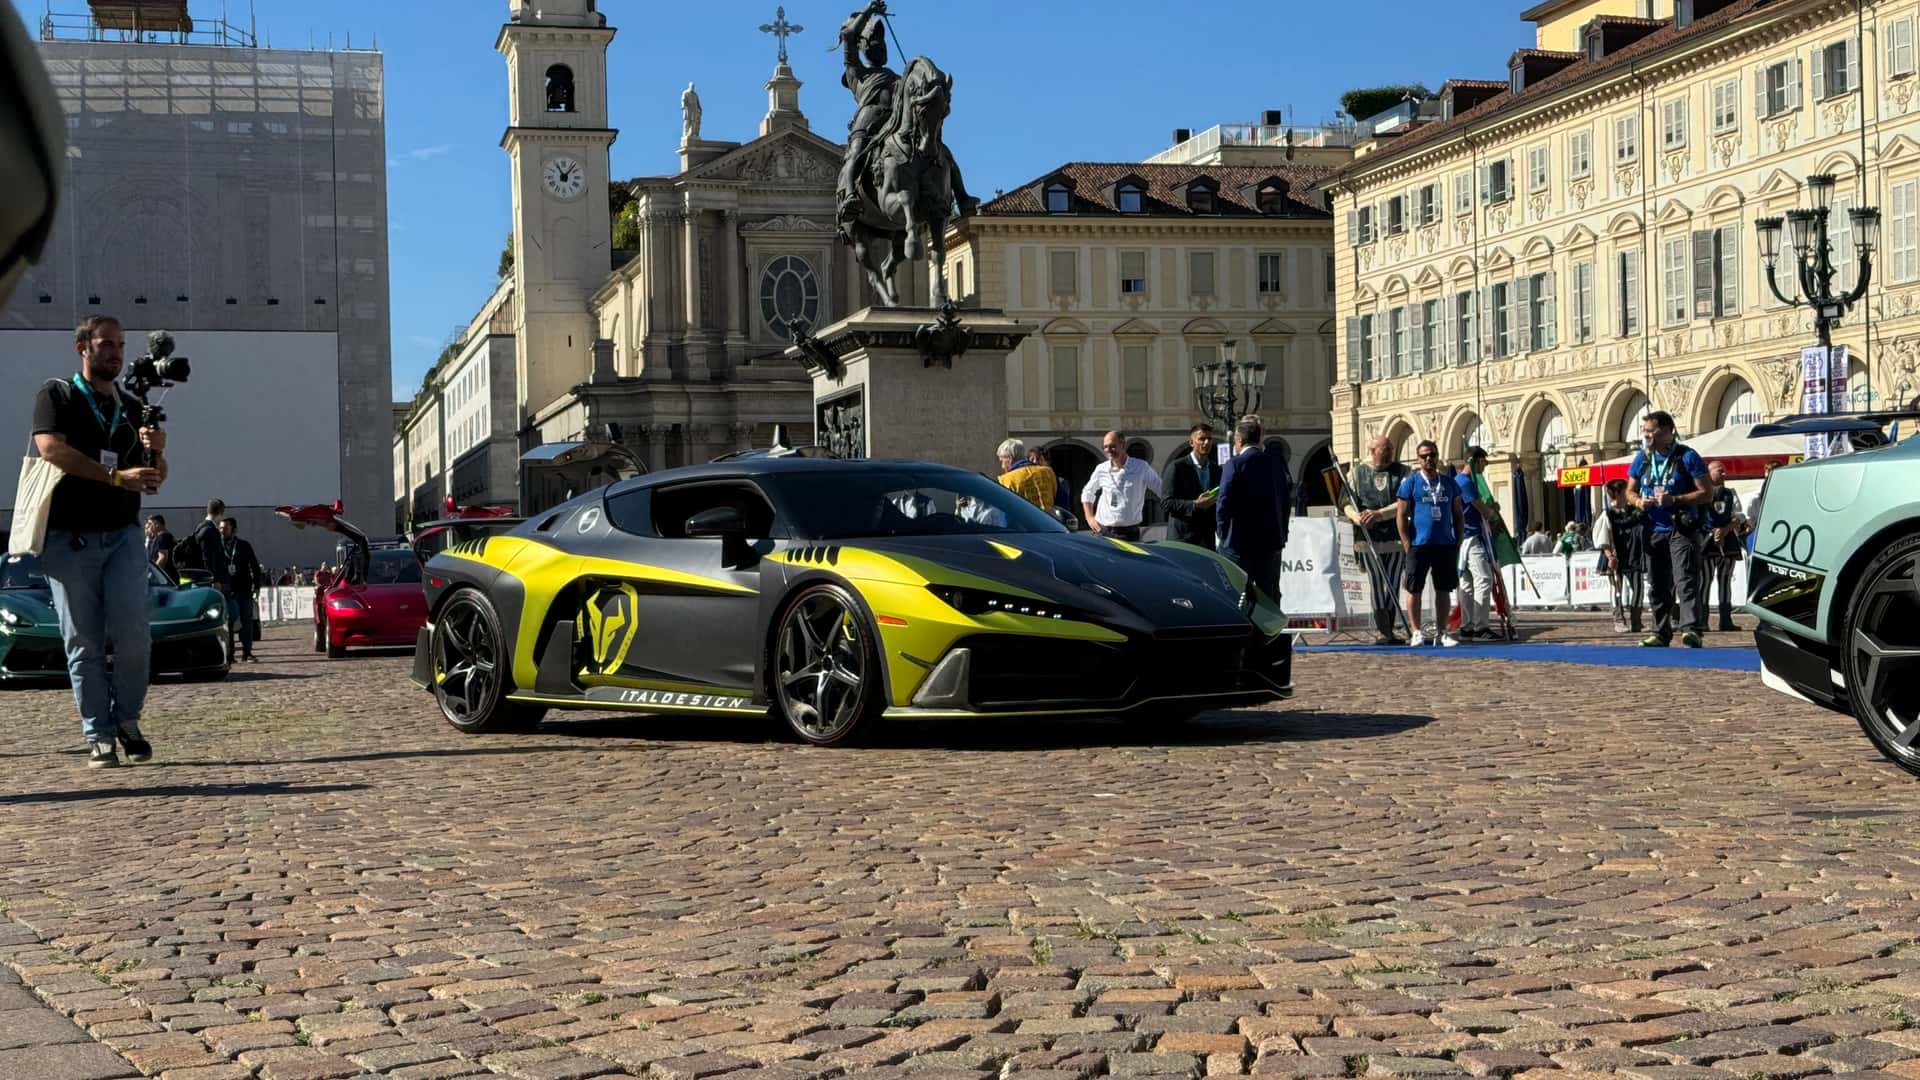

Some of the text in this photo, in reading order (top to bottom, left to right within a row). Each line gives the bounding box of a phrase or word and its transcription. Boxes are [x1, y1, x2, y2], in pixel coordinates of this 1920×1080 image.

[1563, 471, 1587, 483] Sabelt
[1768, 519, 1815, 566] 20
[1767, 563, 1807, 580] TEST CAR
[620, 690, 743, 707] ITALDESIGN
